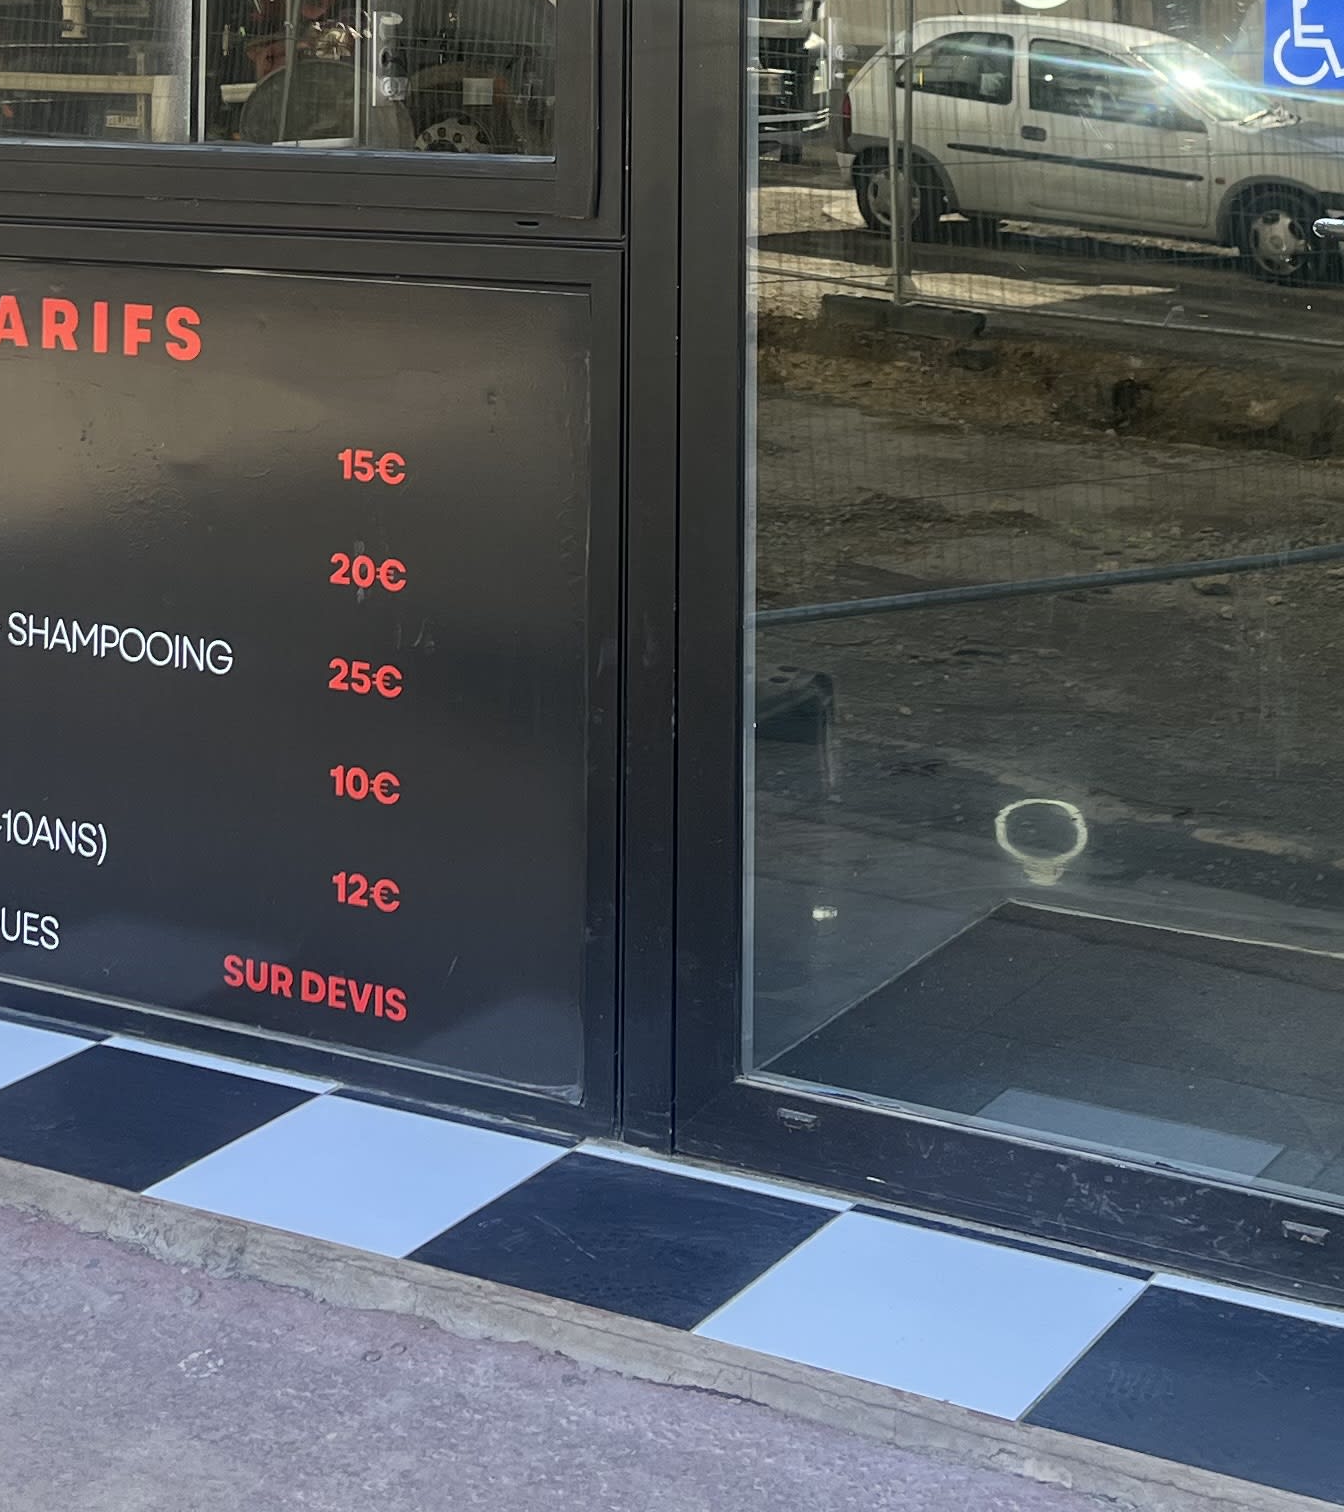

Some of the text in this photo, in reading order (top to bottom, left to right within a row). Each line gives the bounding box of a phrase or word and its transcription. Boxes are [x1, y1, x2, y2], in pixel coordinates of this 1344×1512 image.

[338, 449, 407, 485] 15€
[329, 553, 407, 592] 20€
[7, 613, 234, 675] SHAMPOOING
[328, 658, 403, 698] 25€
[330, 765, 401, 805] 10€
[332, 872, 401, 913] 12€
[222, 954, 408, 1022] SUR DEVIS
